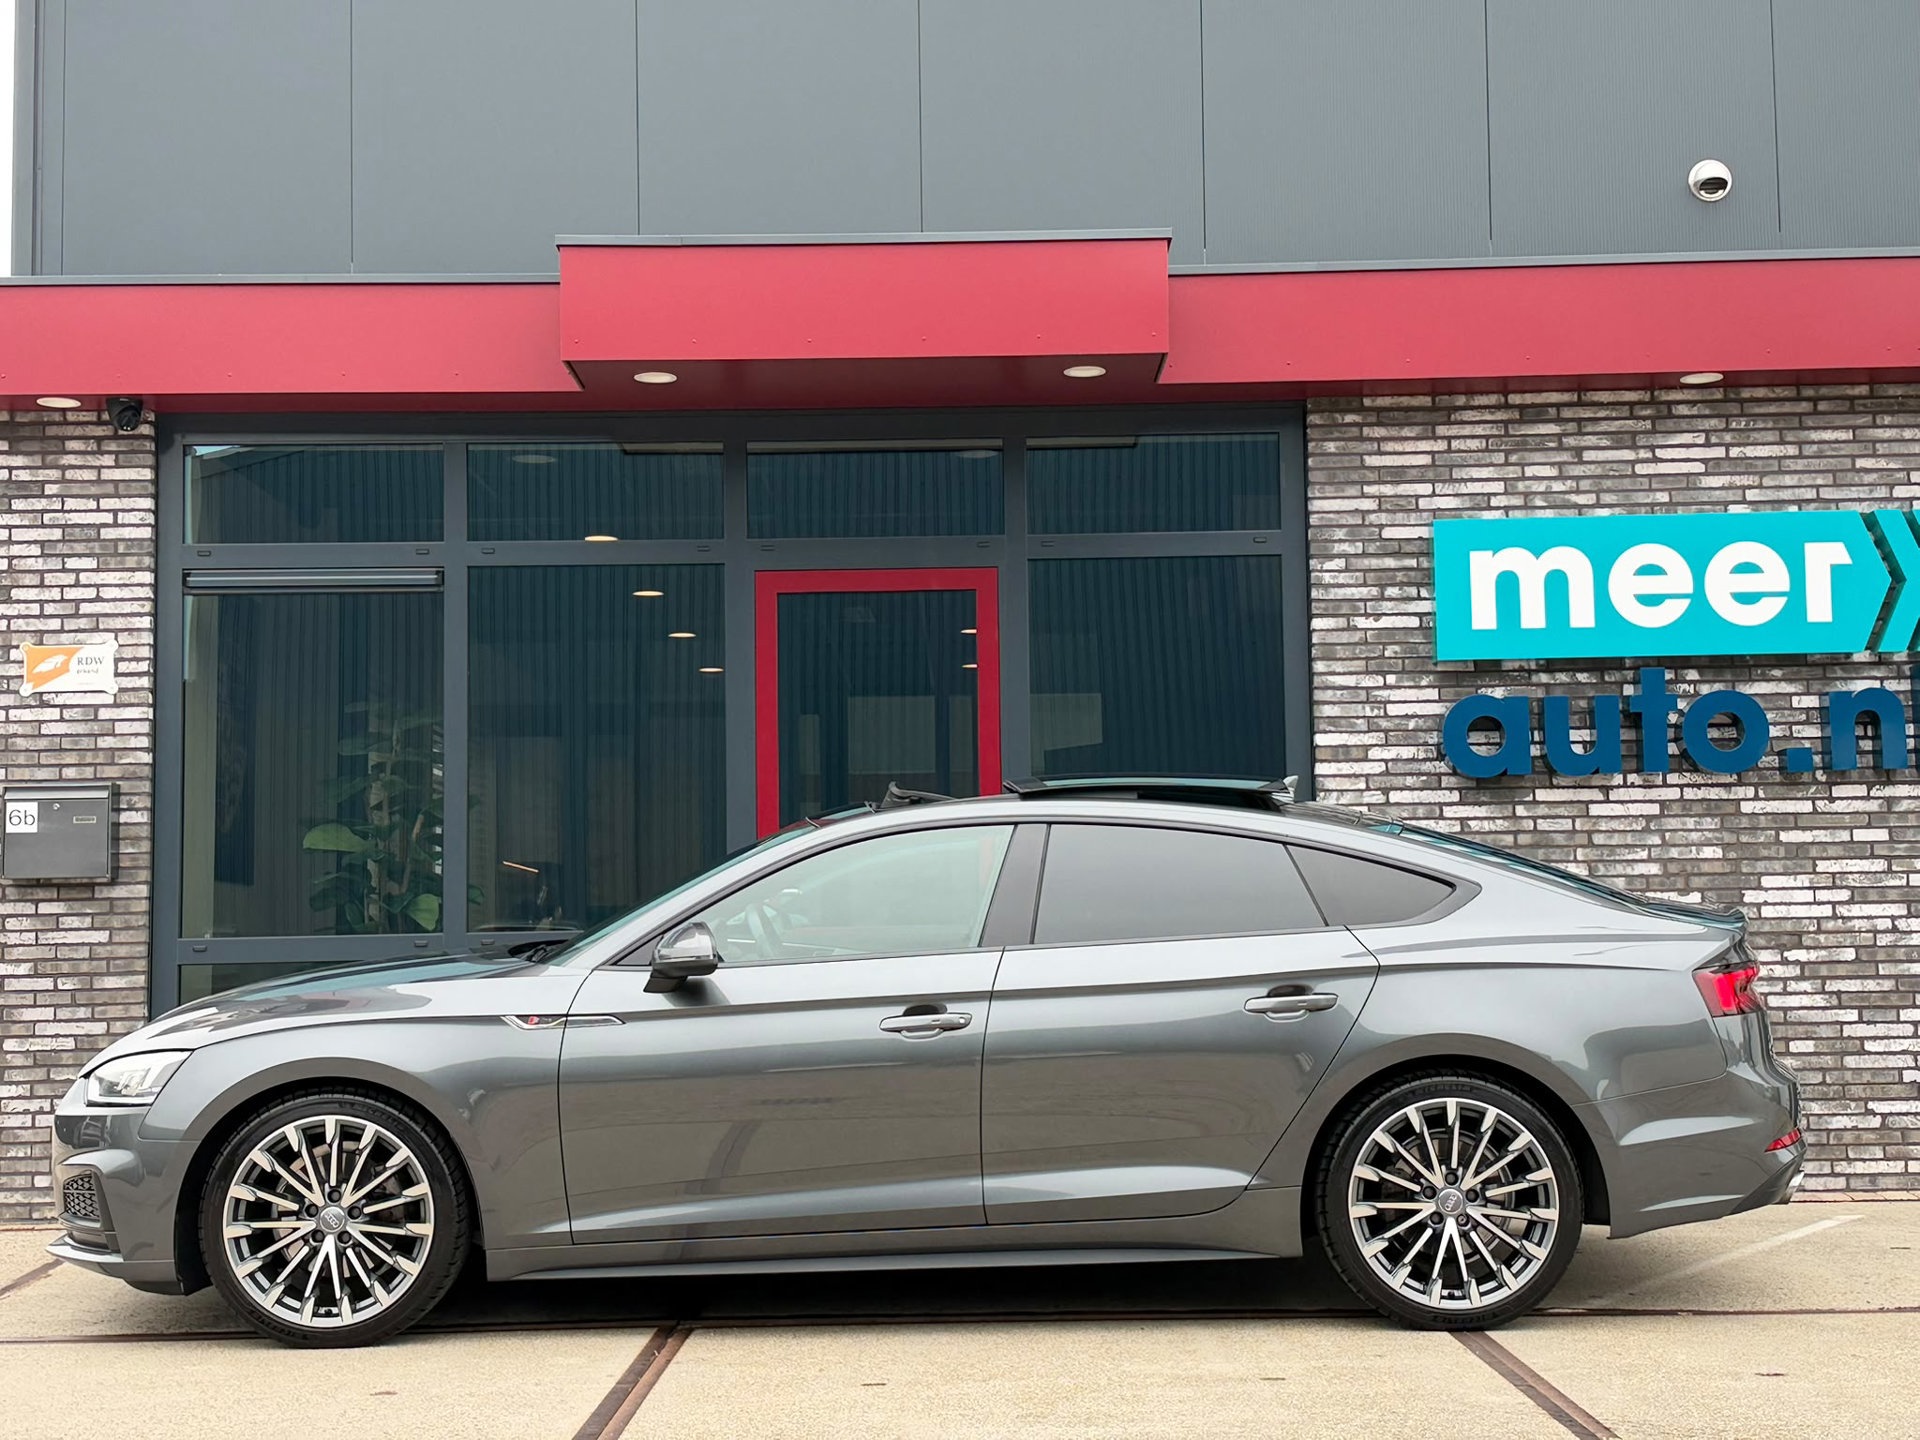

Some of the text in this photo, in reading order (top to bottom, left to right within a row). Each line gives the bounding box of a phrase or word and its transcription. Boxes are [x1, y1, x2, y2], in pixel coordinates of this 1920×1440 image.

[1469, 541, 1853, 630] meer
[76, 655, 105, 666] RDW
[1442, 667, 1920, 778] auto.n
[8, 809, 36, 827] 6b
